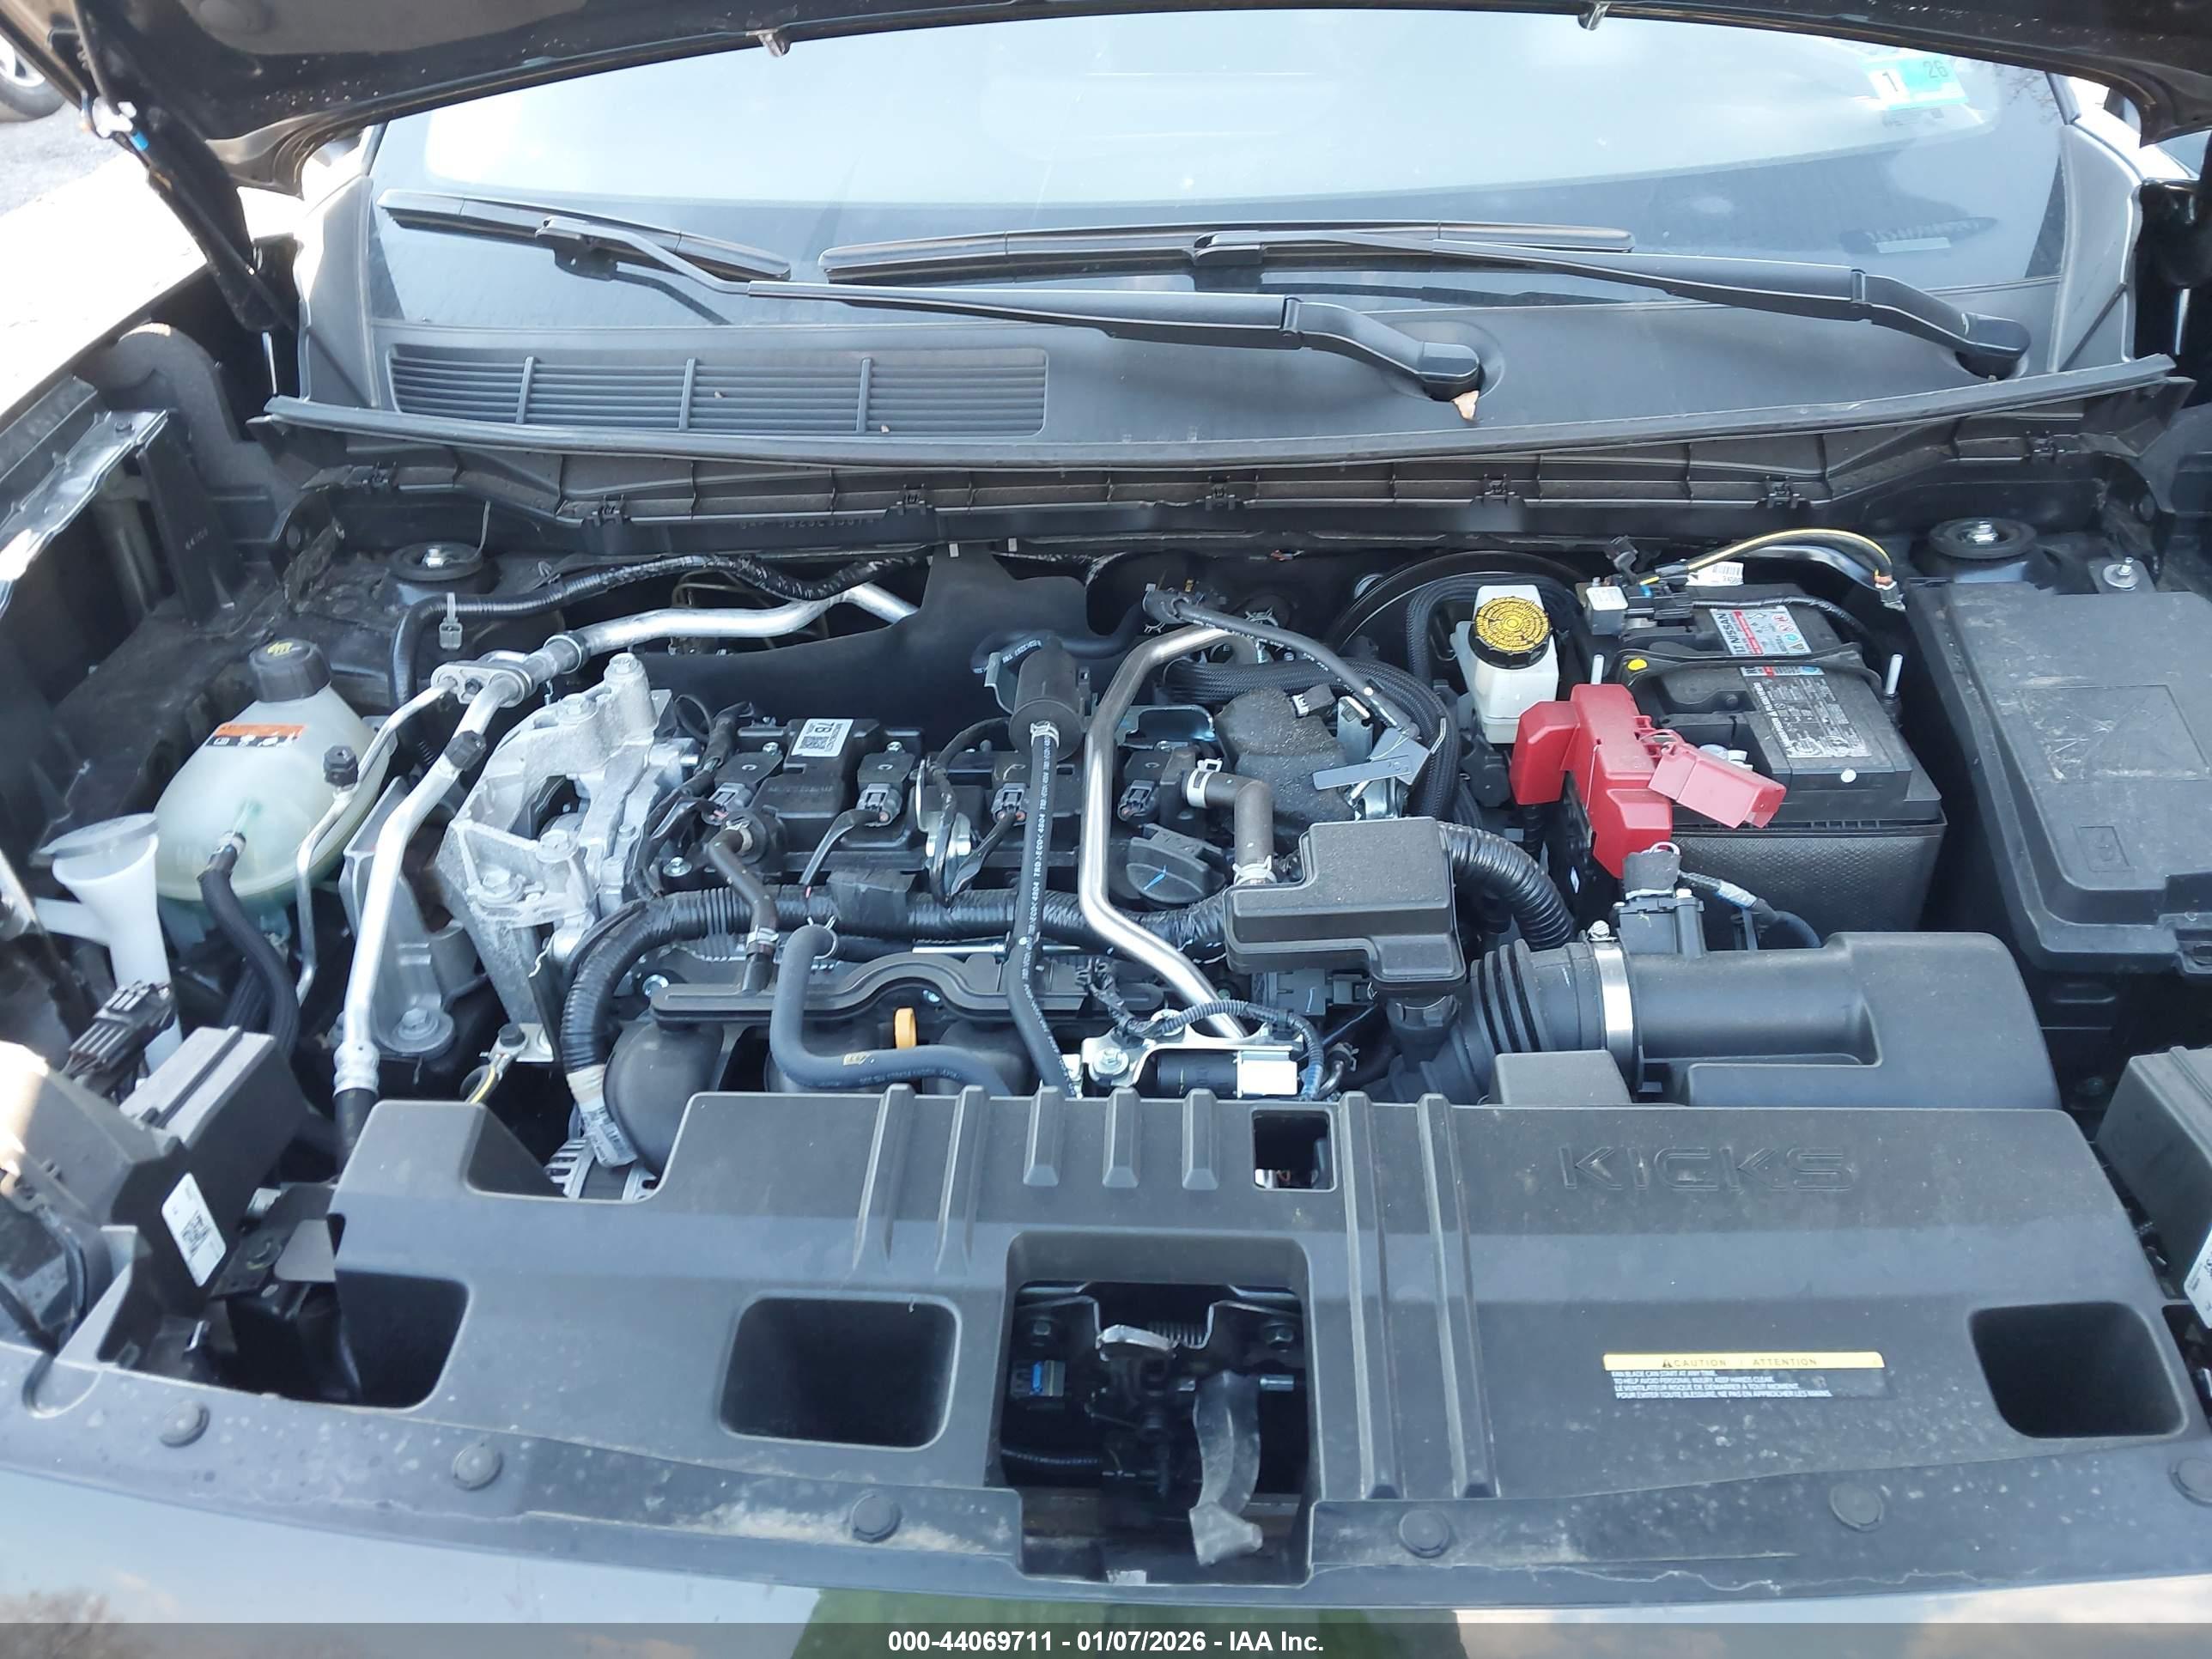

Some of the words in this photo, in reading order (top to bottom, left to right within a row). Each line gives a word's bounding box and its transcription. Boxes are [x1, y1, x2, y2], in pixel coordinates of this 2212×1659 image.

[1923, 60, 1948, 79] 26
[1881, 70, 1899, 92] 1
[1717, 613, 1741, 643] NISSAN
[1559, 1146, 1856, 1192] KICKS
[1674, 1359, 1727, 1368] CAUTION
